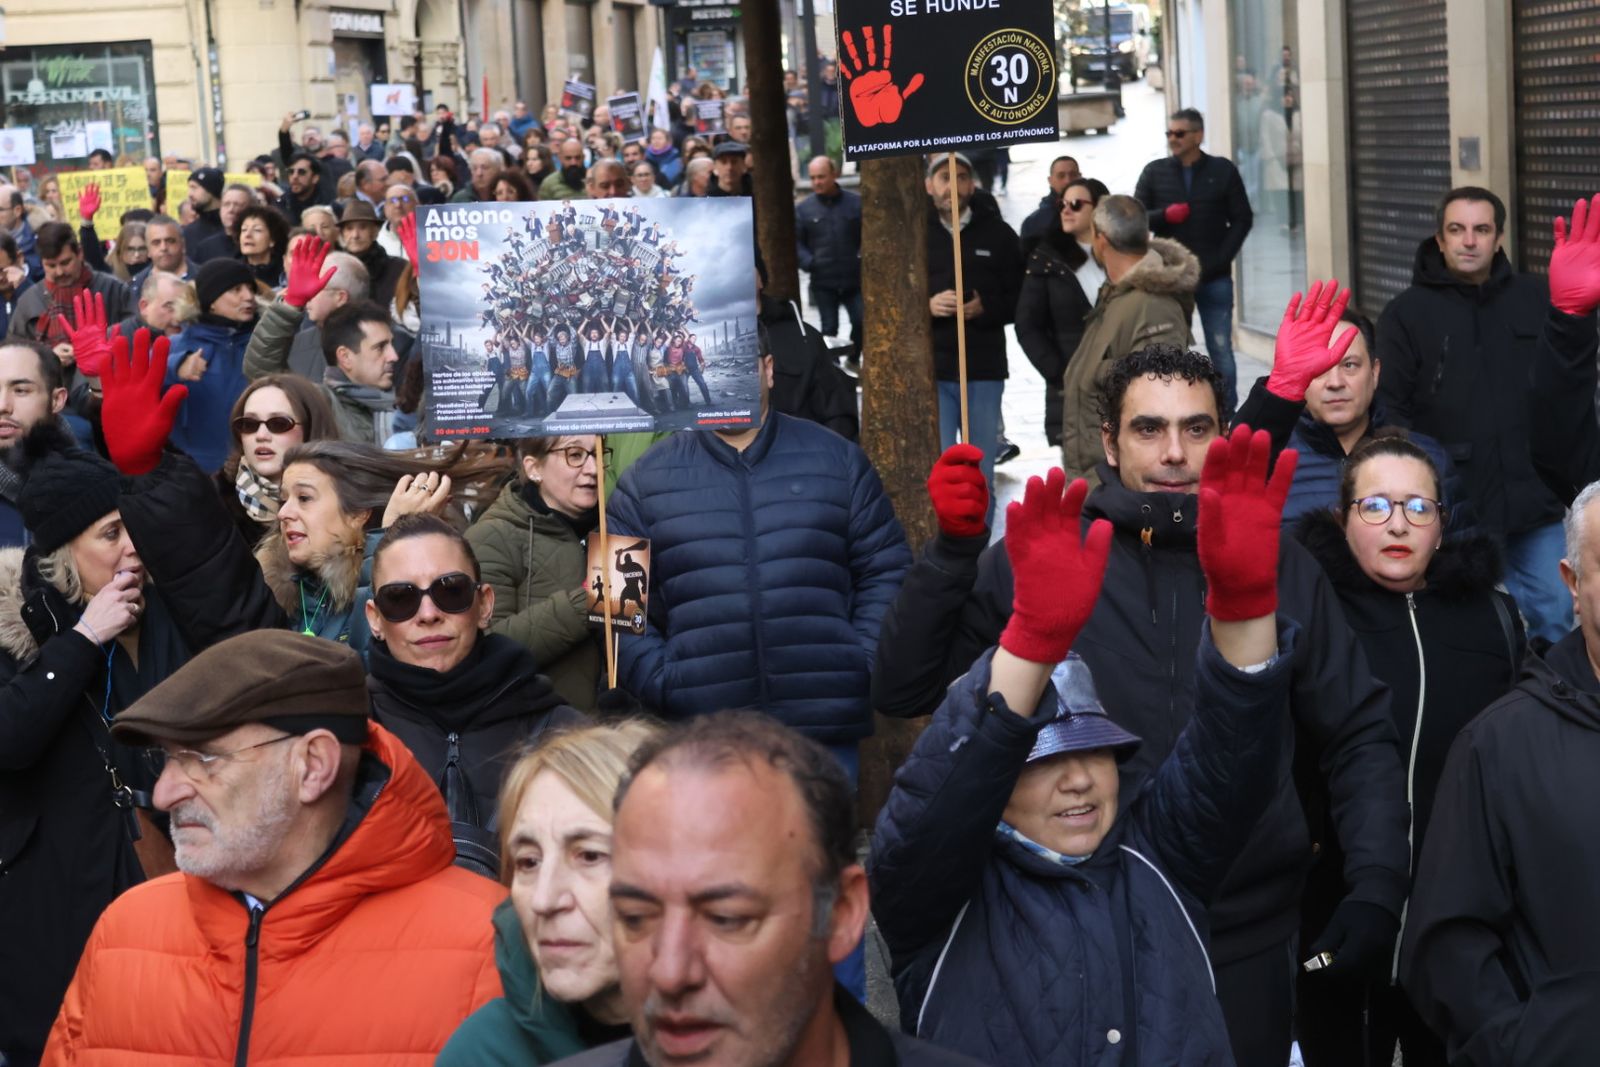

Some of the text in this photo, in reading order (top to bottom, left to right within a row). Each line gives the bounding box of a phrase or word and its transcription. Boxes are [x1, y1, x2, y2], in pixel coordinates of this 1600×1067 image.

[890, 0, 918, 16] SE
[970, 33, 1050, 76] MANIFESTACIÓN NACIONAL
[991, 53, 1028, 86] 30
[1004, 86, 1018, 104] N
[979, 94, 1045, 120] DE AUTÓNOMOS
[848, 142, 902, 153] PLATAFORMA
[904, 140, 920, 148] POR
[922, 138, 932, 146] LA
[934, 135, 972, 145] DIGNIDAD
[1003, 127, 1054, 138] AUTÓNOMOS
[424, 208, 512, 226] Autono
[426, 226, 478, 241] mos
[426, 240, 479, 262] 30N
